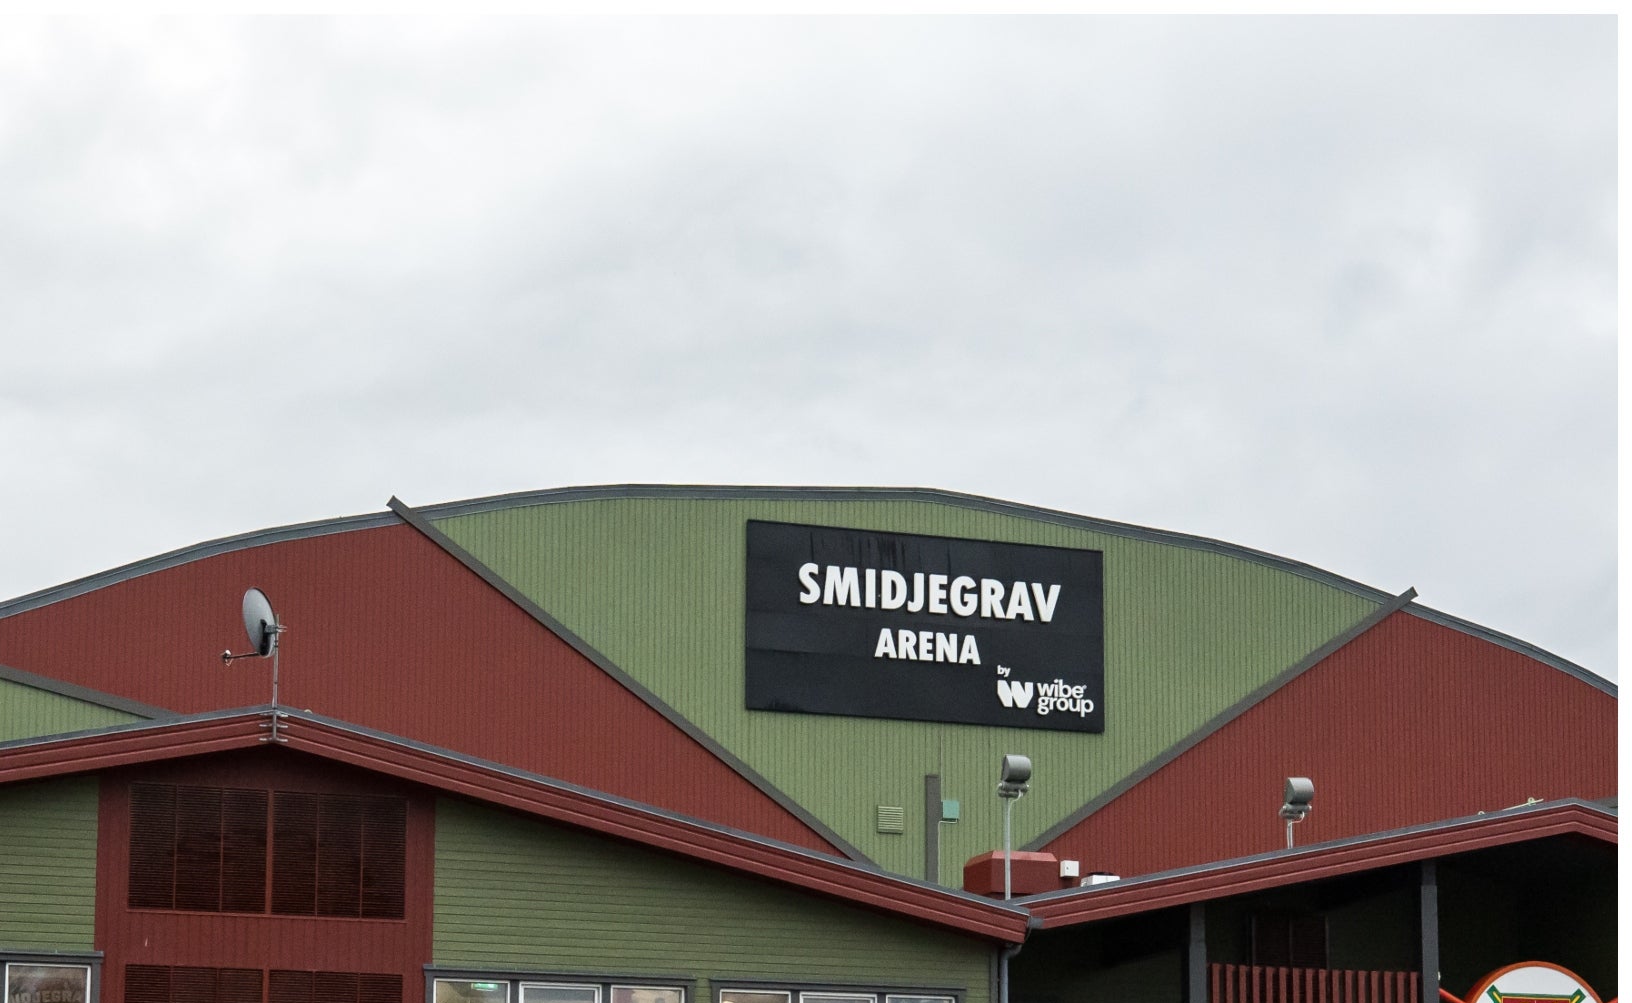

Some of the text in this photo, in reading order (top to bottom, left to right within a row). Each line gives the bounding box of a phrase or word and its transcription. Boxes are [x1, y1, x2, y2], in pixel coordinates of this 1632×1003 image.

[798, 562, 1061, 622] SMIDJEGRAV
[874, 628, 981, 664] ARENA
[997, 665, 1011, 677] by
[1037, 696, 1094, 718] group
